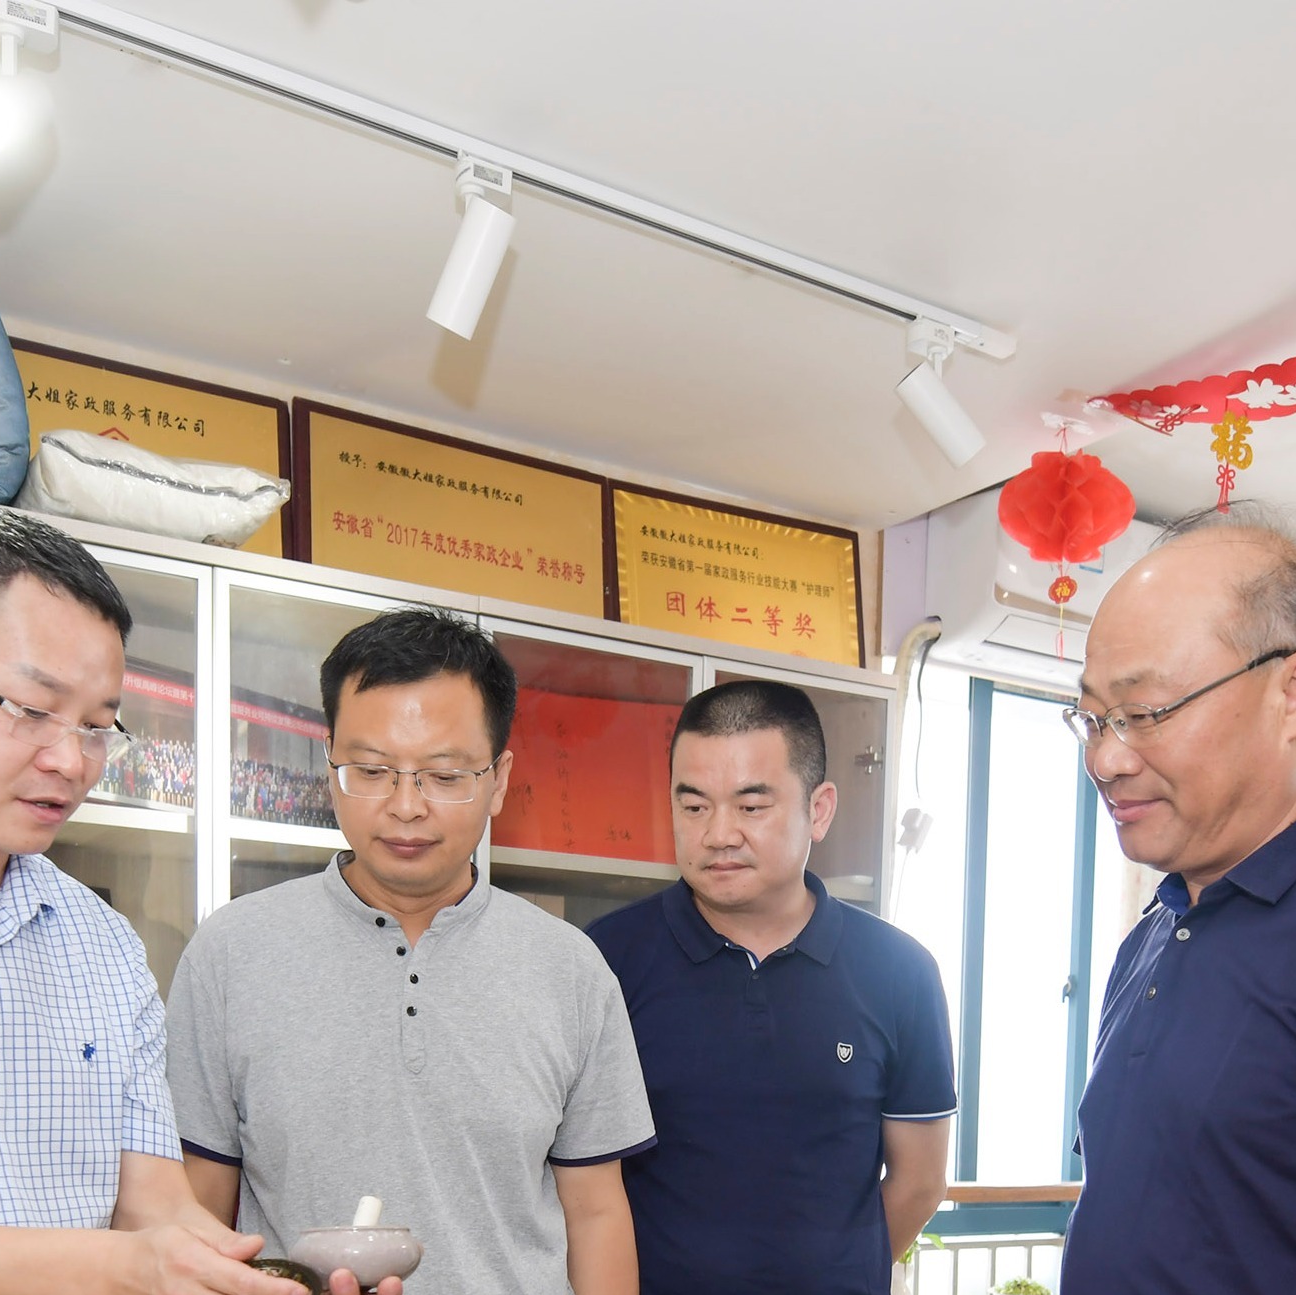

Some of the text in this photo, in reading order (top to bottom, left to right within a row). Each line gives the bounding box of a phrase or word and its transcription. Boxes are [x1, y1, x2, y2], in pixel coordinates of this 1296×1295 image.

[26, 381, 205, 438] 大姐家政服务有限公司
[1210, 411, 1253, 470] 福
[666, 591, 816, 639] 团体二等奖
